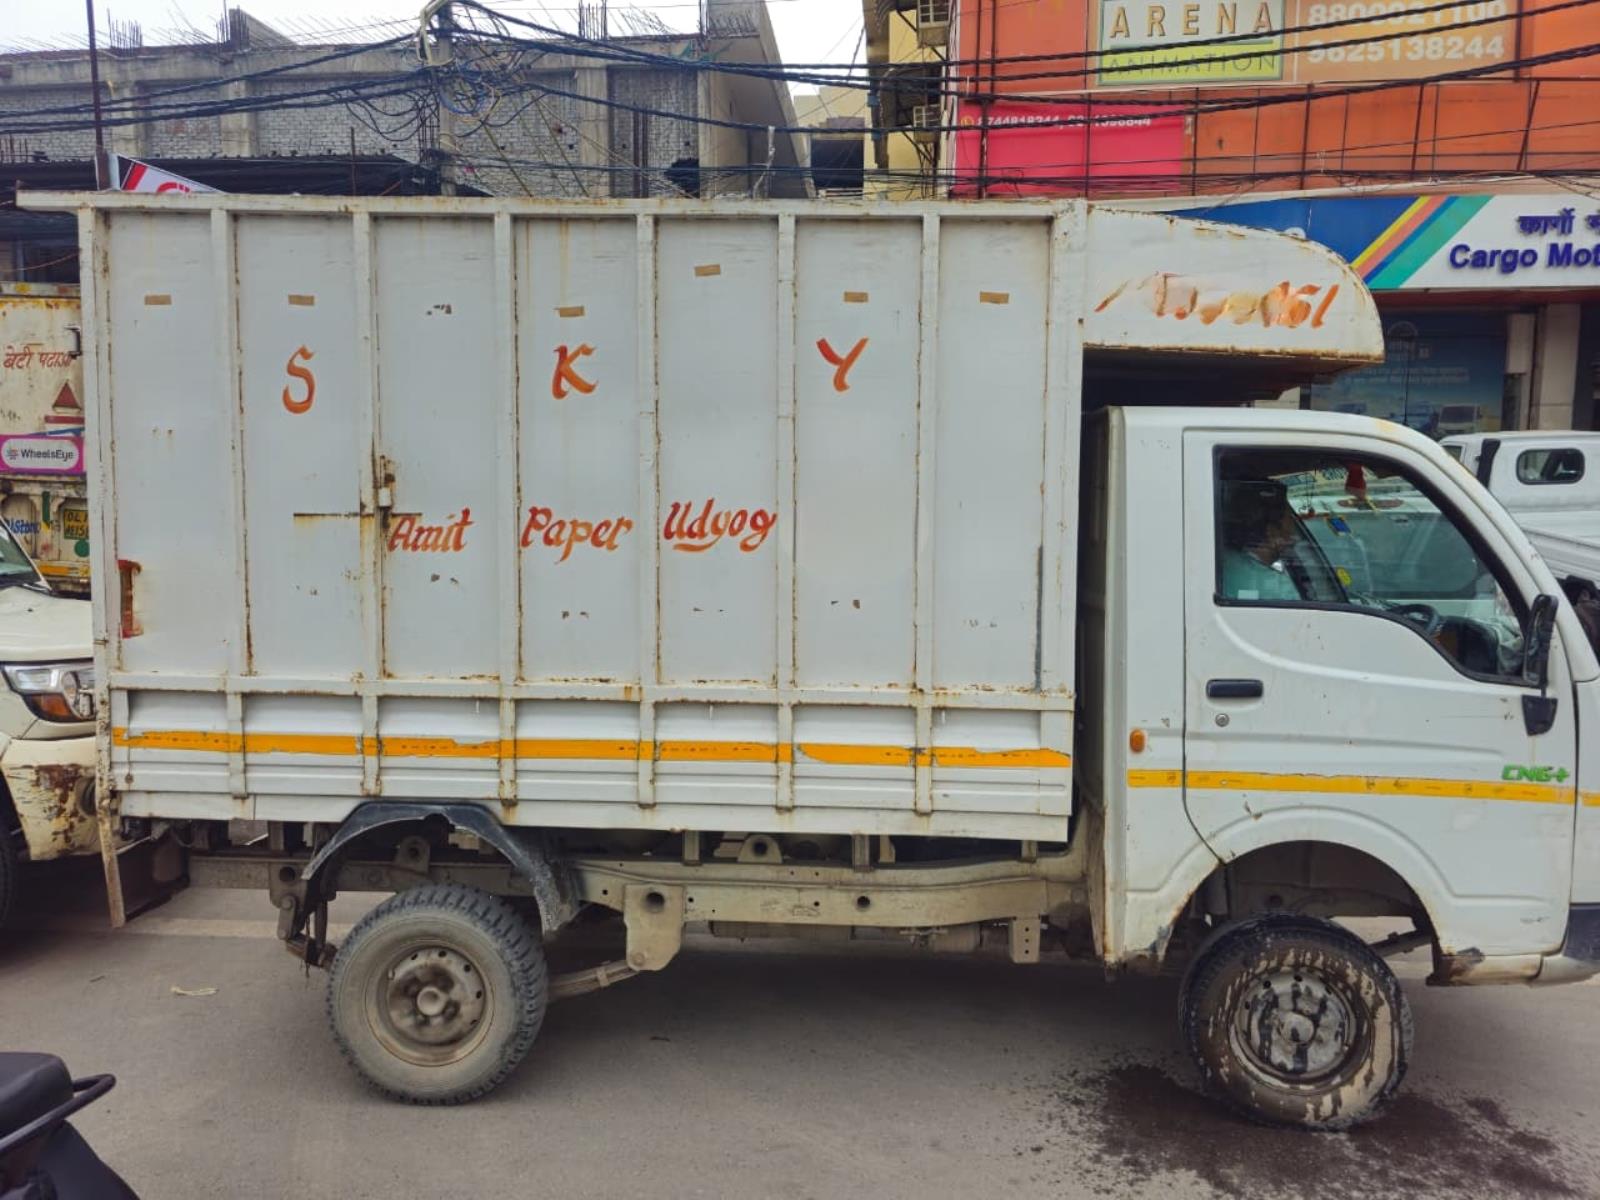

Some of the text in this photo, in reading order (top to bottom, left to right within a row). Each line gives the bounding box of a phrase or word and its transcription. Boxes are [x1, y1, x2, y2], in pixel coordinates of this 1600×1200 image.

[1109, 2, 1273, 38] ARENA
[1108, 52, 1276, 76] ANIMATION
[1449, 243, 1539, 274] Cargo
[282, 337, 869, 414] S K Y
[20, 448, 74, 461] WheelsEye
[387, 498, 778, 565] Amit Paper Udyog
